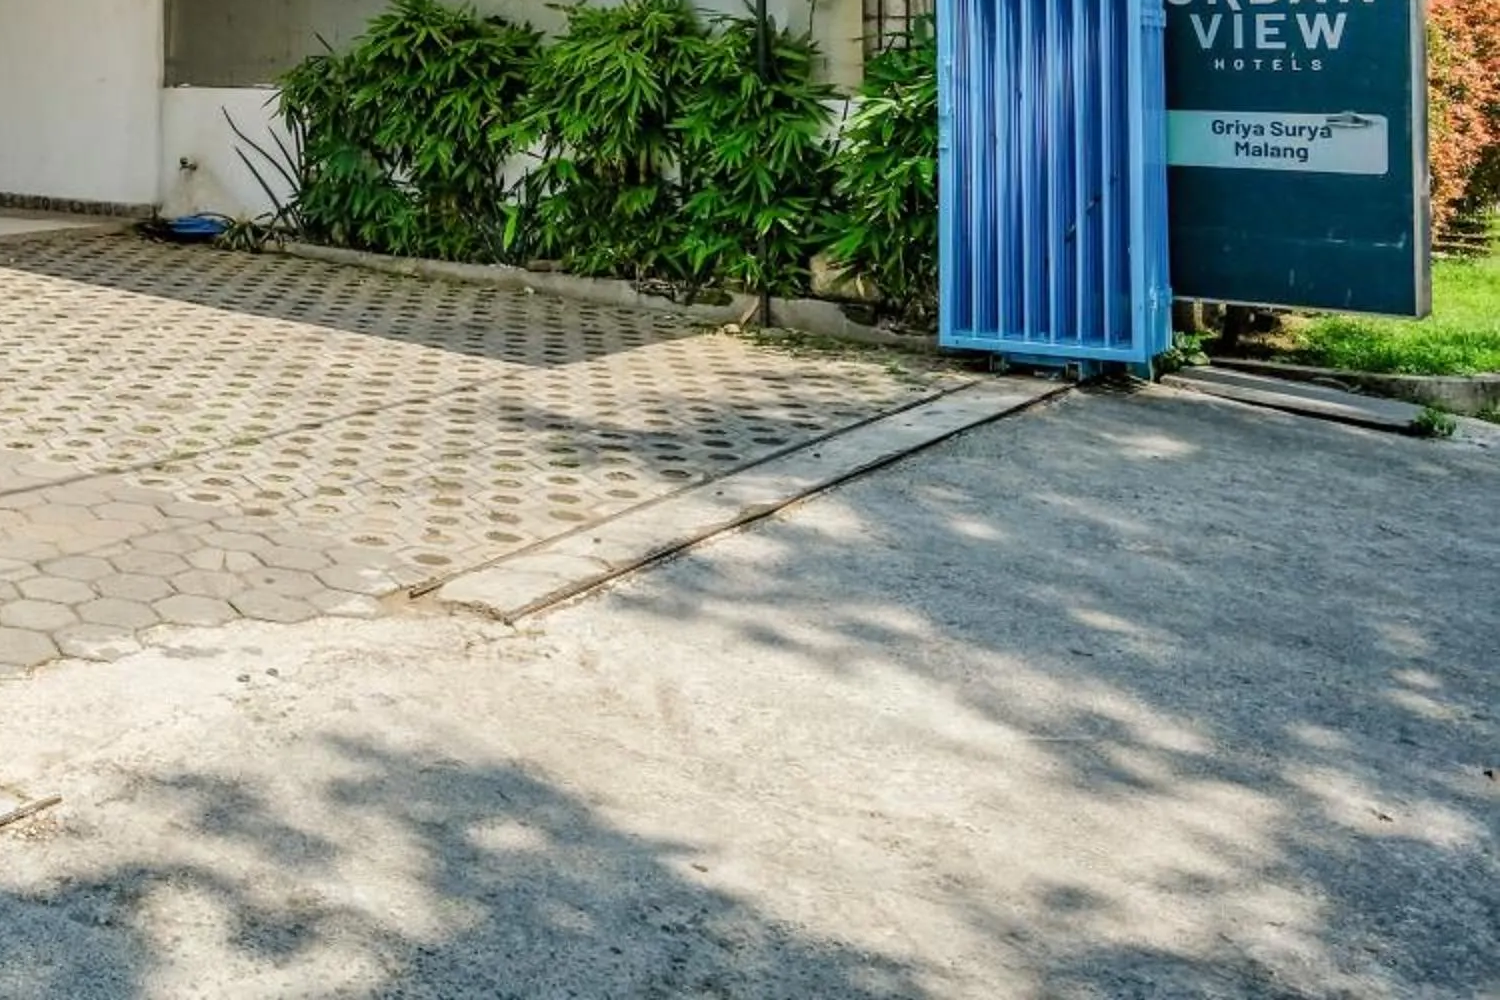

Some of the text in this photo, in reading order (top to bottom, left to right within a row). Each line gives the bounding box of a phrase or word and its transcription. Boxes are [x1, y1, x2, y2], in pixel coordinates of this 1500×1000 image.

[1189, 12, 1348, 49] VIEW
[1213, 58, 1323, 71] HOTELS
[1211, 119, 1333, 141] Griya Surya
[1234, 141, 1309, 162] Malang
